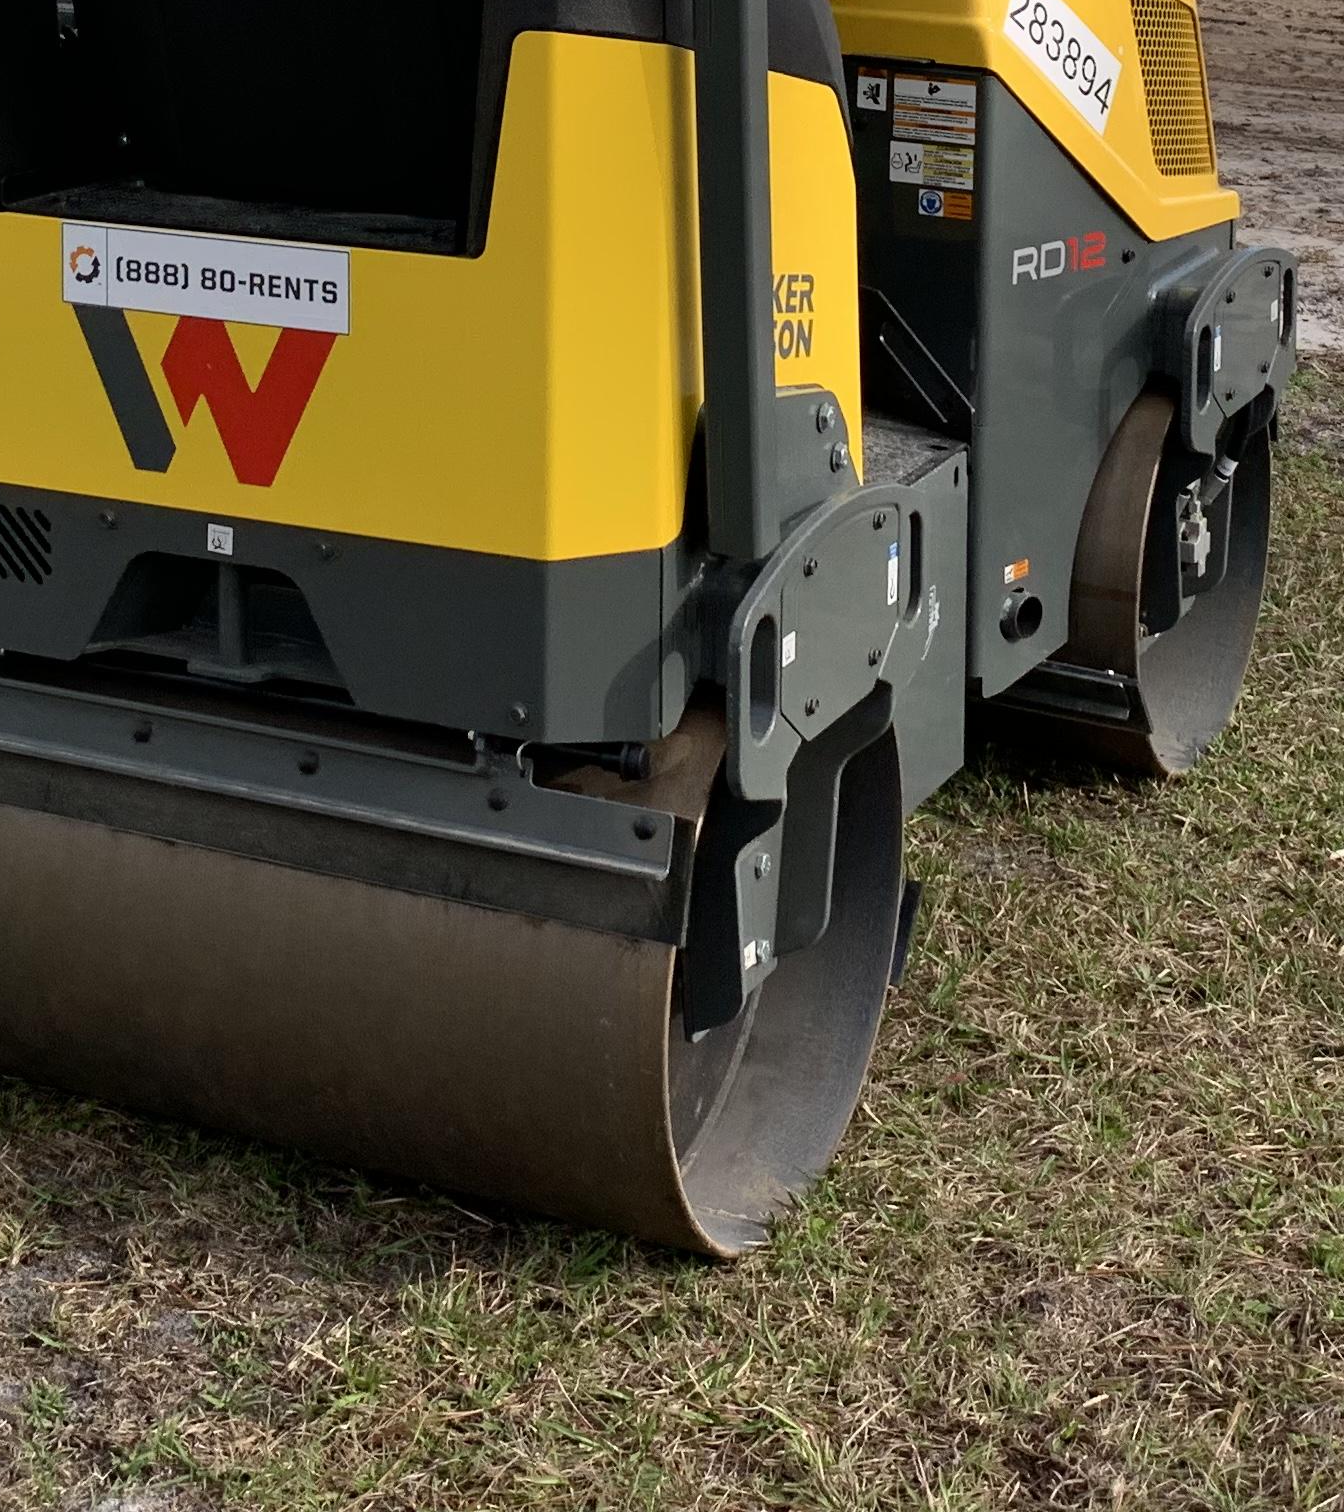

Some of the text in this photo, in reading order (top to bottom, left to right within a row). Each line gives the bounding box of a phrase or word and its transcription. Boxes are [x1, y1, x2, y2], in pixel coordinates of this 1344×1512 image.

[116, 256, 338, 304] (888) 80-RENTS
[1012, 231, 1106, 285] RD12
[771, 319, 814, 360] ON
